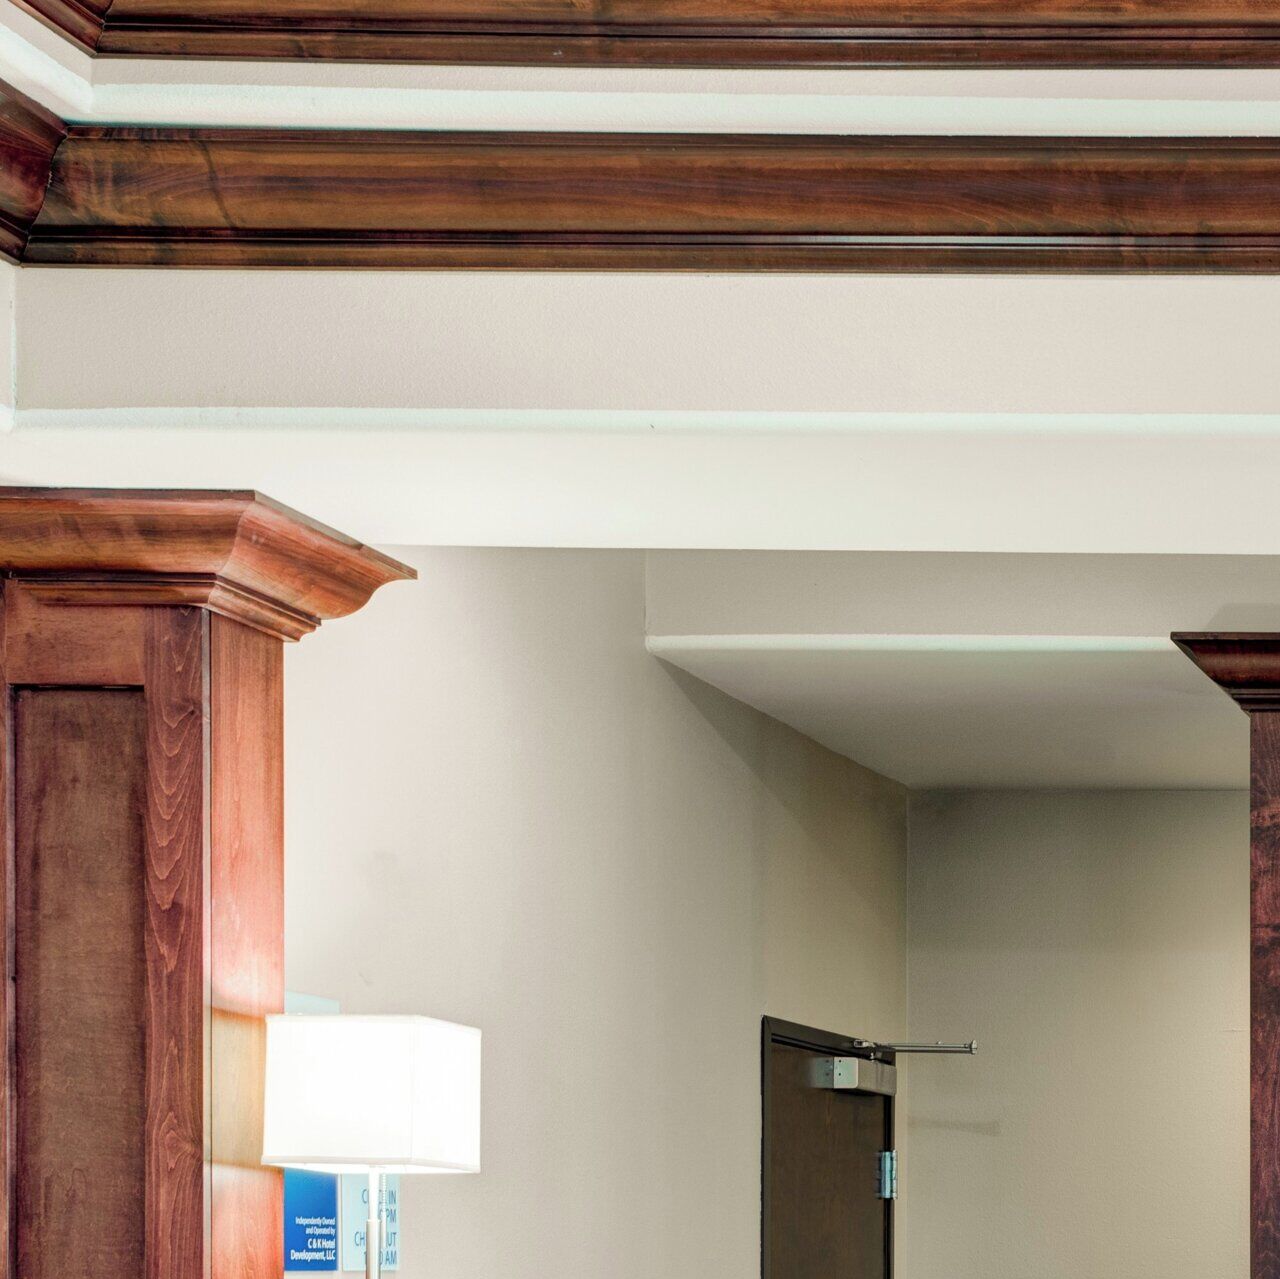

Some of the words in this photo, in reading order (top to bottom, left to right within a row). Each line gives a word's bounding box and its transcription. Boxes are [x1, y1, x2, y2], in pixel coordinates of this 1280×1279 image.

[389, 1189, 397, 1205] IN
[295, 1216, 321, 1226] Independently
[322, 1216, 336, 1225] Owned
[305, 1226, 313, 1235] and
[314, 1226, 330, 1236] Operated
[331, 1226, 336, 1236] by
[308, 1238, 312, 1249] C
[312, 1238, 317, 1249] &
[317, 1238, 322, 1249] K
[322, 1238, 336, 1249] Hotel
[290, 1249, 326, 1262] Development,
[326, 1249, 336, 1261] LLC
[385, 1250, 397, 1265] AM
